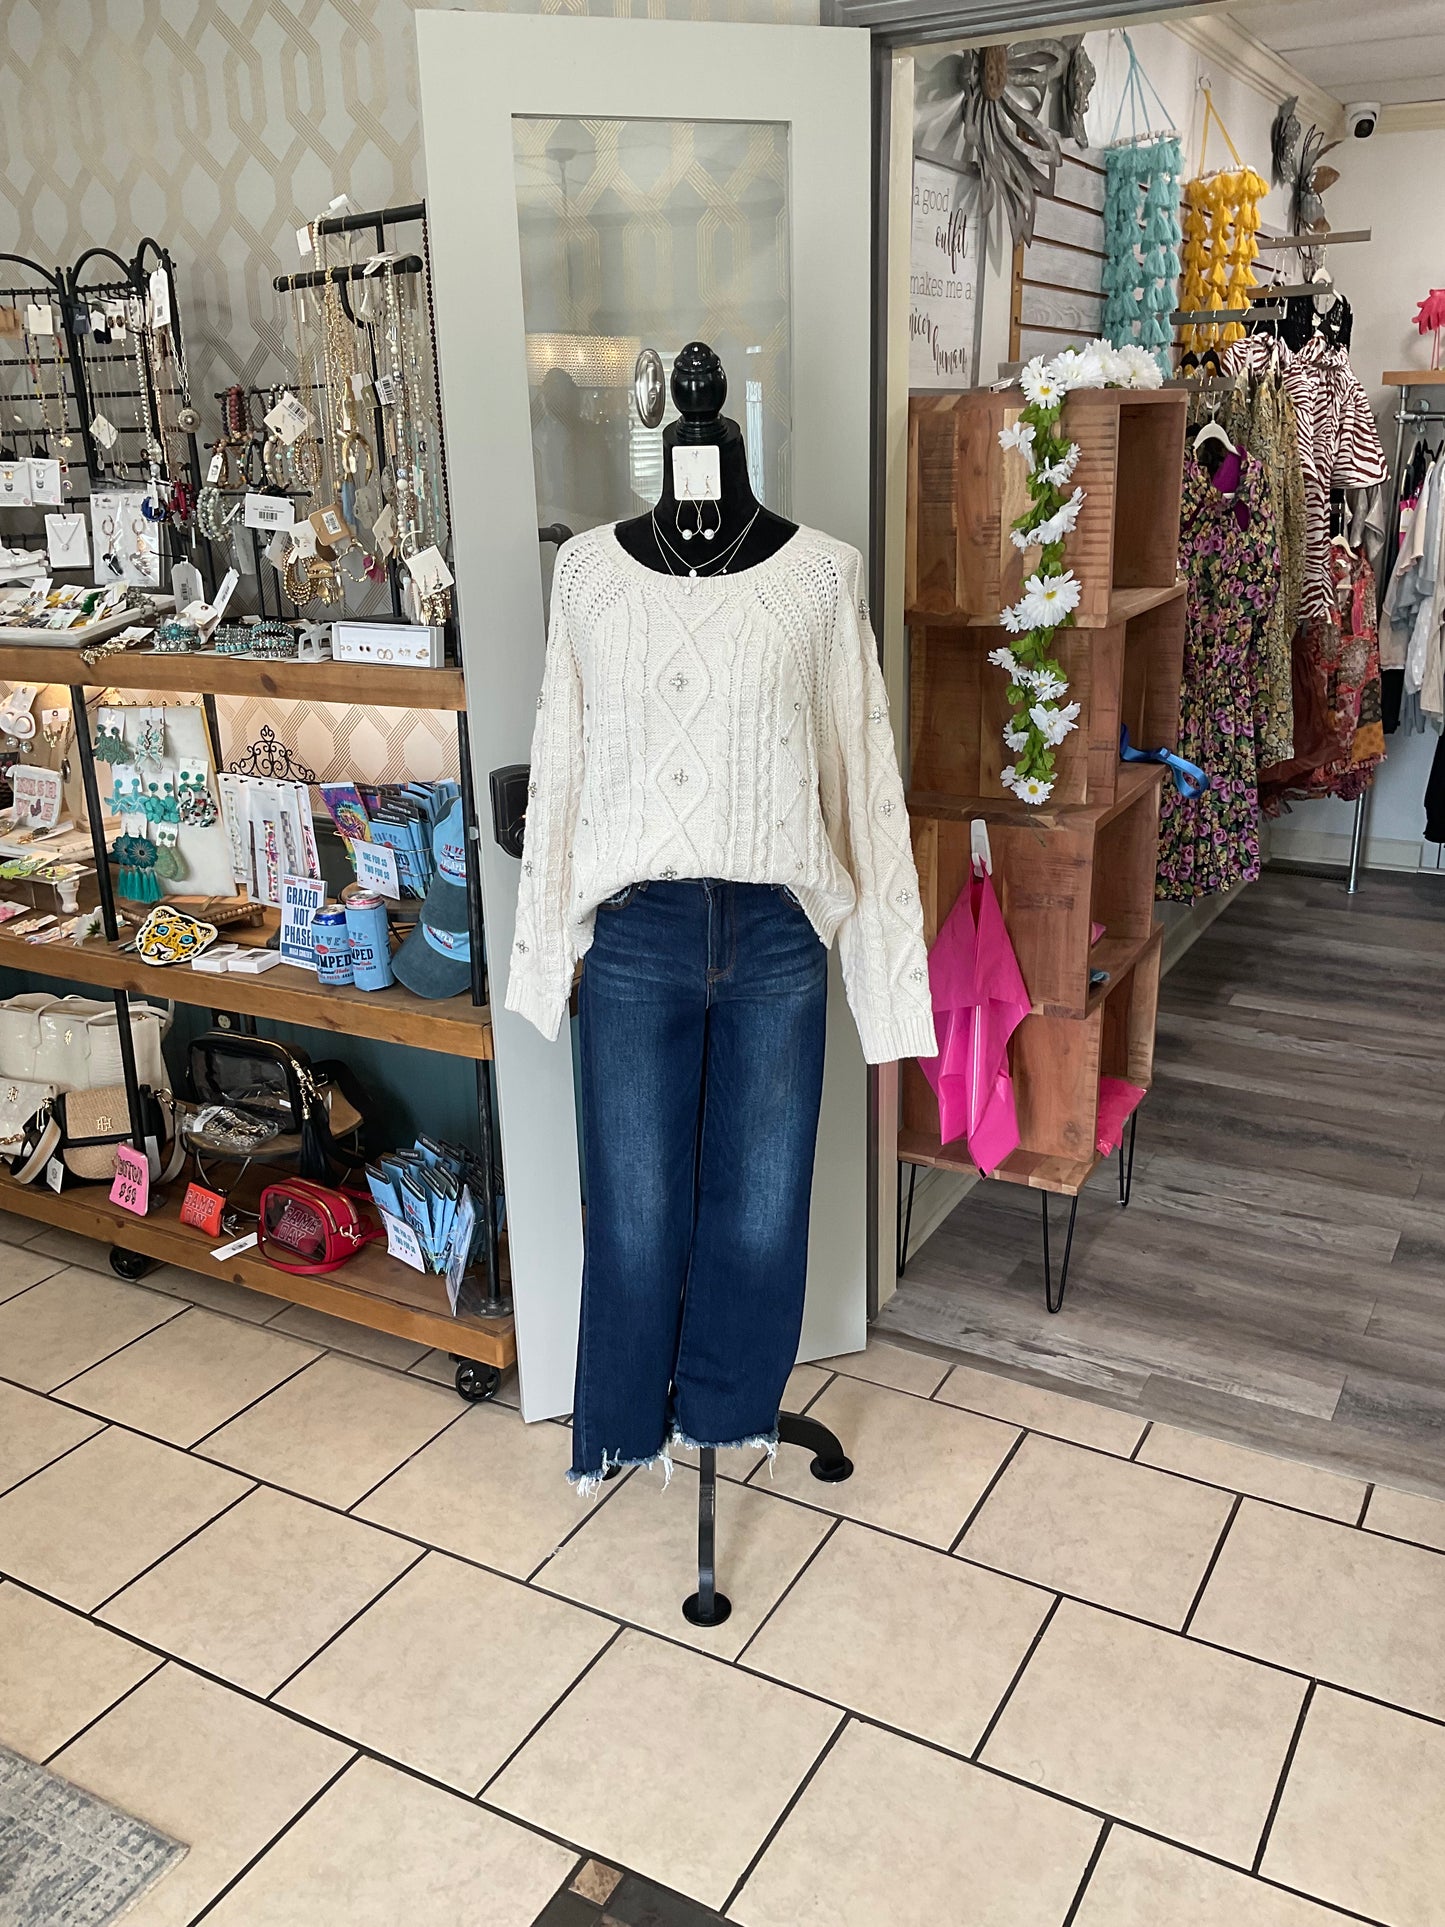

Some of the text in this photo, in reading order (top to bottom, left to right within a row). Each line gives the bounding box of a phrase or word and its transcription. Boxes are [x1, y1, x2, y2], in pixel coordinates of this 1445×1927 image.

[913, 186, 950, 215] a good
[935, 208, 968, 275] outfit
[910, 271, 972, 300] makes me a
[909, 307, 931, 343] nicer
[932, 325, 967, 376] human
[16, 777, 57, 799] NASH
[286, 886, 318, 909] GRAZED
[293, 907, 310, 927] NOT
[184, 1189, 217, 1217] GAME
[184, 1207, 207, 1227] DAY
[281, 1206, 322, 1236] GAME
[278, 1223, 307, 1248] DAY
